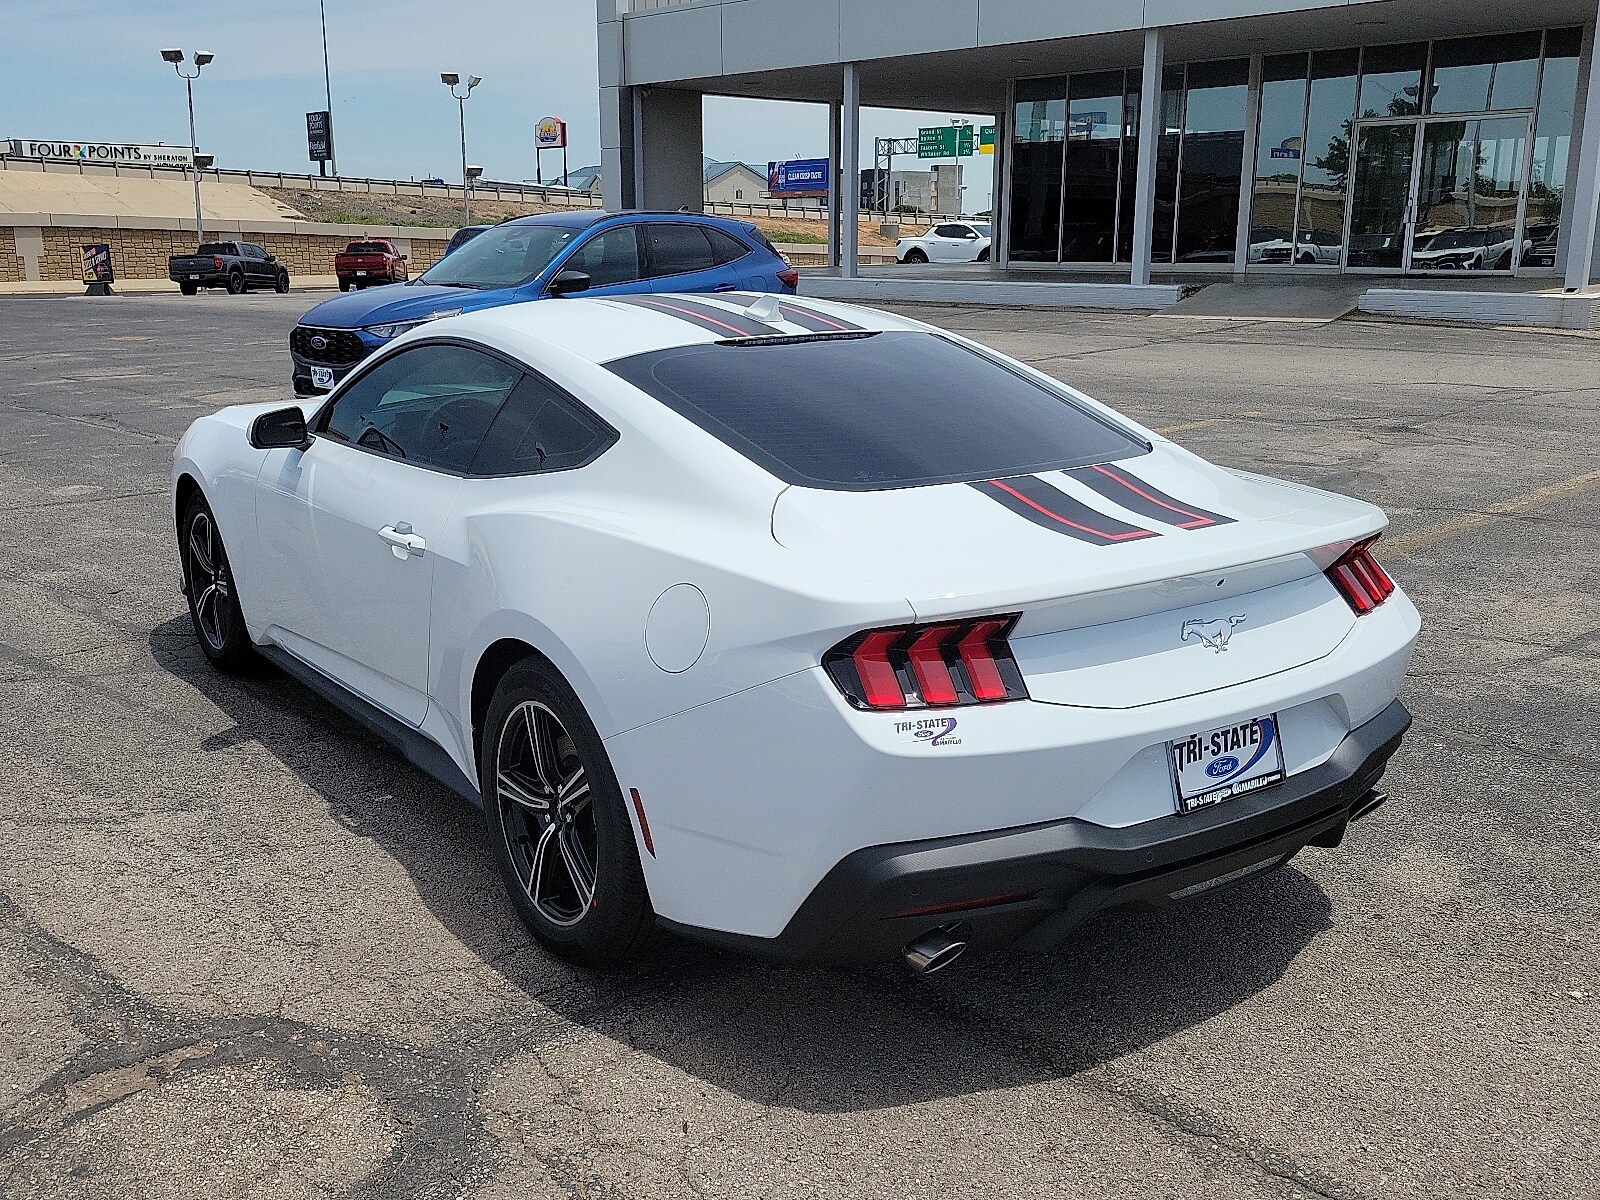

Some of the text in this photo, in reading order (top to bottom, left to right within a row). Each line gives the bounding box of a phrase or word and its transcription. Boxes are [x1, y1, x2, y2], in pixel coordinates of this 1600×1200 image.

[29, 143, 74, 157] FOUR
[88, 145, 141, 159] POINTS
[894, 718, 948, 734] TRI-STATE
[1174, 721, 1259, 773] TRI-STATE
[1213, 760, 1233, 774] Ford
[1186, 793, 1216, 810] TRI-STATE
